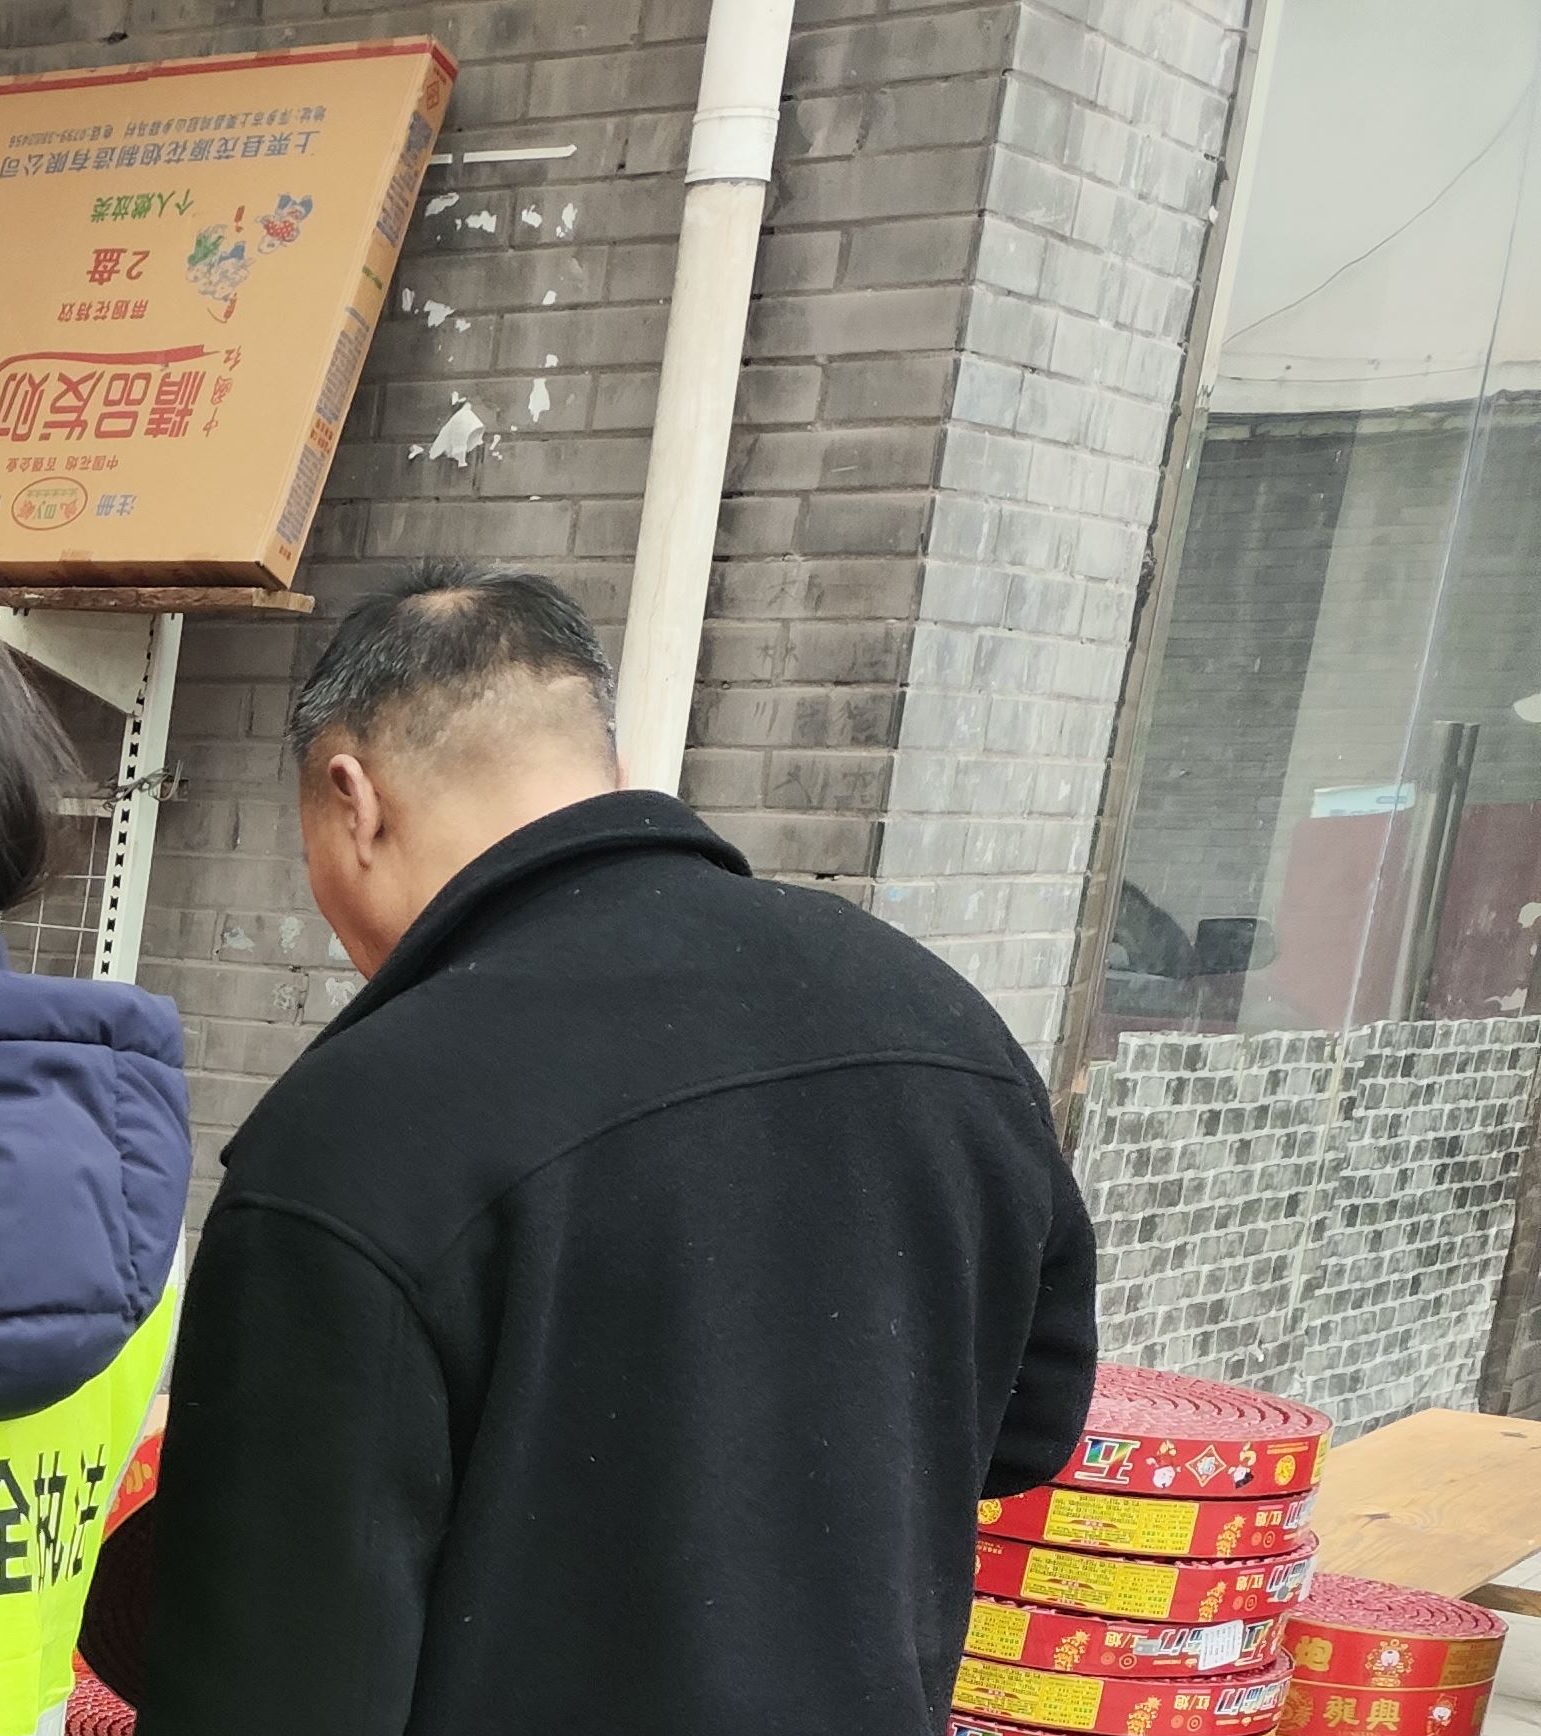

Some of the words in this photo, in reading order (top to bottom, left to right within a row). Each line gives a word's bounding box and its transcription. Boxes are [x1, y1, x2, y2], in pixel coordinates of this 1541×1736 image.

[90, 189, 195, 223] 个人燃放类
[87, 247, 150, 286] 2盘
[56, 298, 150, 323] 带烟花特效
[97, 494, 138, 518] 注册
